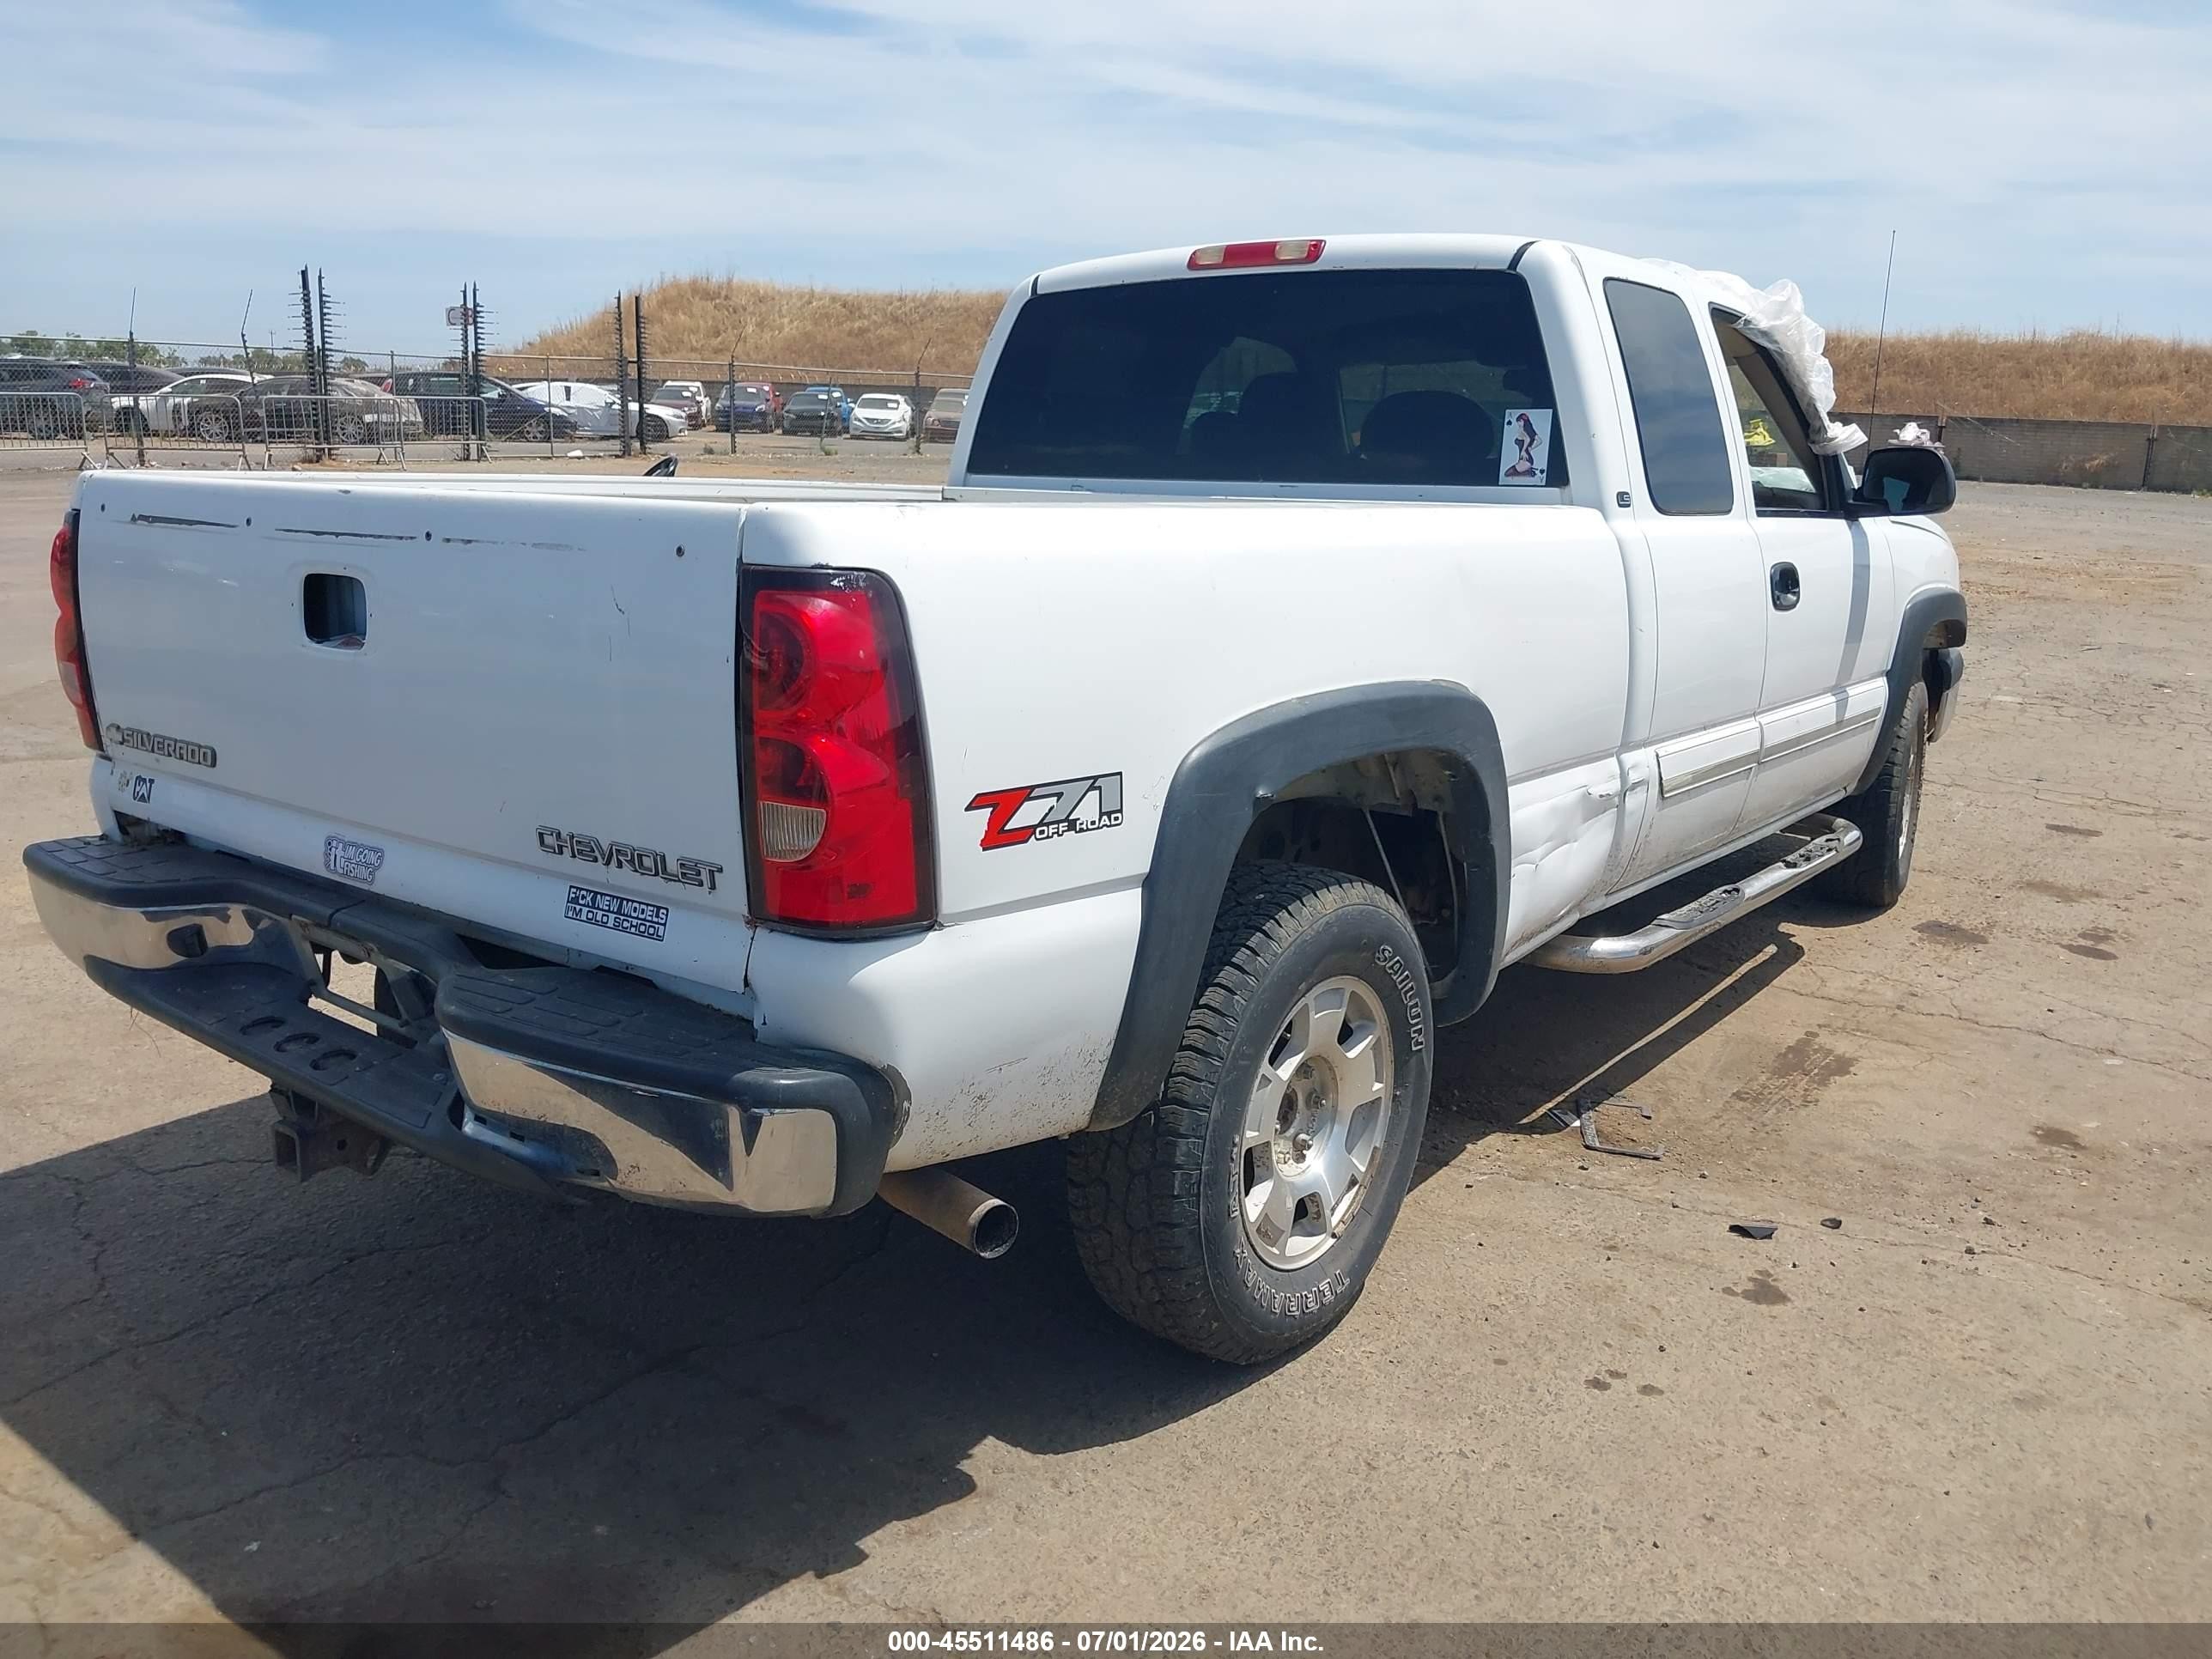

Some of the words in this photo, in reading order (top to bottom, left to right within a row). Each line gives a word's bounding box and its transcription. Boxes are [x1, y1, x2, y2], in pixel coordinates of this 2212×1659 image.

[122, 729, 216, 767] SILVERADO
[132, 775, 155, 804] CAT
[964, 771, 1122, 852] Z71
[1035, 822, 1069, 841] OFF
[343, 861, 374, 882] FISHING
[356, 848, 382, 866] GOING
[536, 825, 723, 890] CHEVROLET
[566, 905, 583, 919] I'M
[586, 910, 610, 925] OLD
[612, 916, 663, 939] SCHOOL
[595, 894, 620, 914] NEW
[621, 901, 667, 925] MODELS
[1374, 945, 1425, 1051] SAILUN
[1233, 1236, 1351, 1318] TERRAMAX
